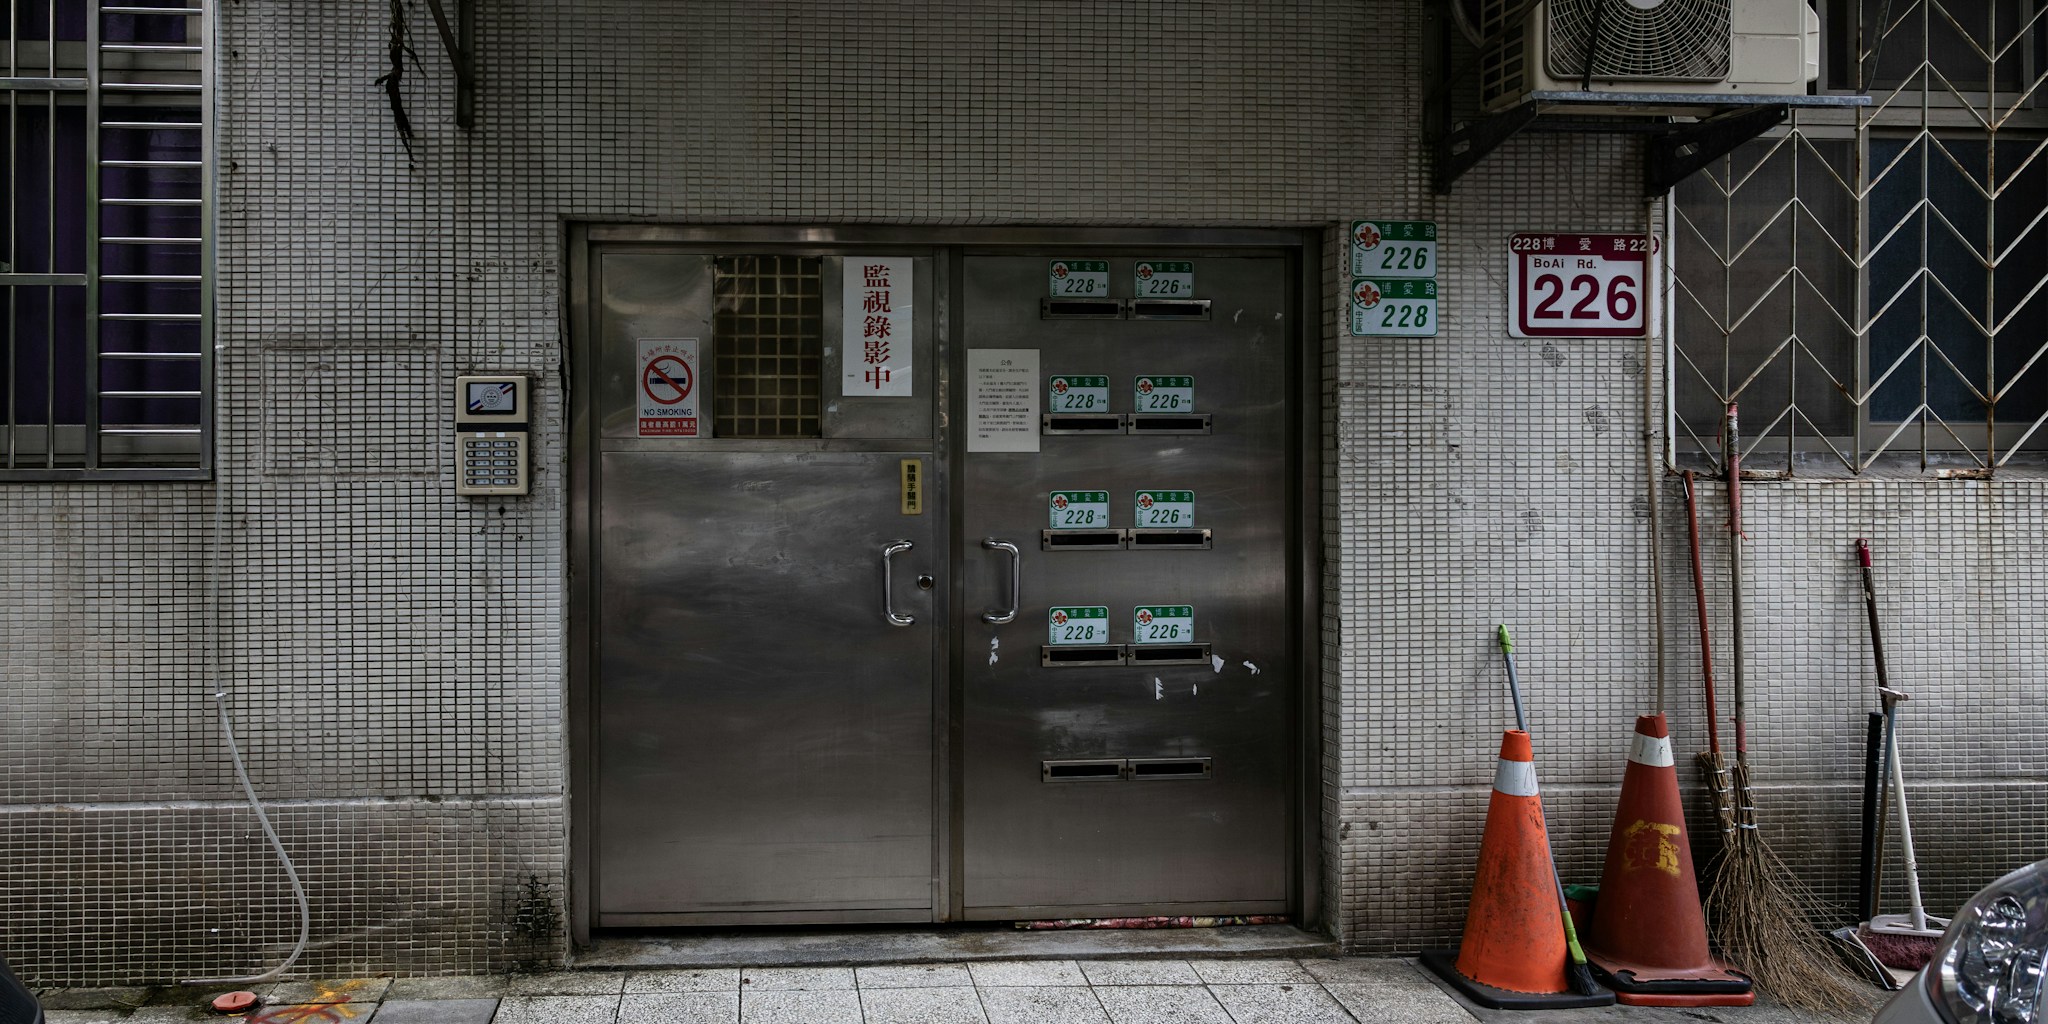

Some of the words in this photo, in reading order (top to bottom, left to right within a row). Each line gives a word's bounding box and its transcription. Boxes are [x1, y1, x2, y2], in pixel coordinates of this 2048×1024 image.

[1382, 224, 1434, 238] 博愛路
[1513, 238, 1541, 251] 228
[1543, 237, 1626, 252] 博愛路
[1381, 247, 1428, 269] 226
[1534, 258, 1564, 268] BoAi
[1577, 259, 1597, 269] Rd.
[1065, 279, 1094, 293] 228
[1150, 280, 1179, 293] 226
[1382, 282, 1435, 295] 博愛路
[1533, 273, 1637, 321] 226
[1381, 304, 1428, 327] 228
[863, 264, 891, 390] 監視錄影中
[1065, 394, 1094, 408] 228
[1150, 394, 1179, 408] 226
[644, 408, 655, 416] NO
[657, 408, 692, 416] SMOKING
[1065, 510, 1094, 524] 228
[1150, 509, 1179, 523] 226
[1064, 625, 1094, 640] 228
[1149, 624, 1179, 639] 226
